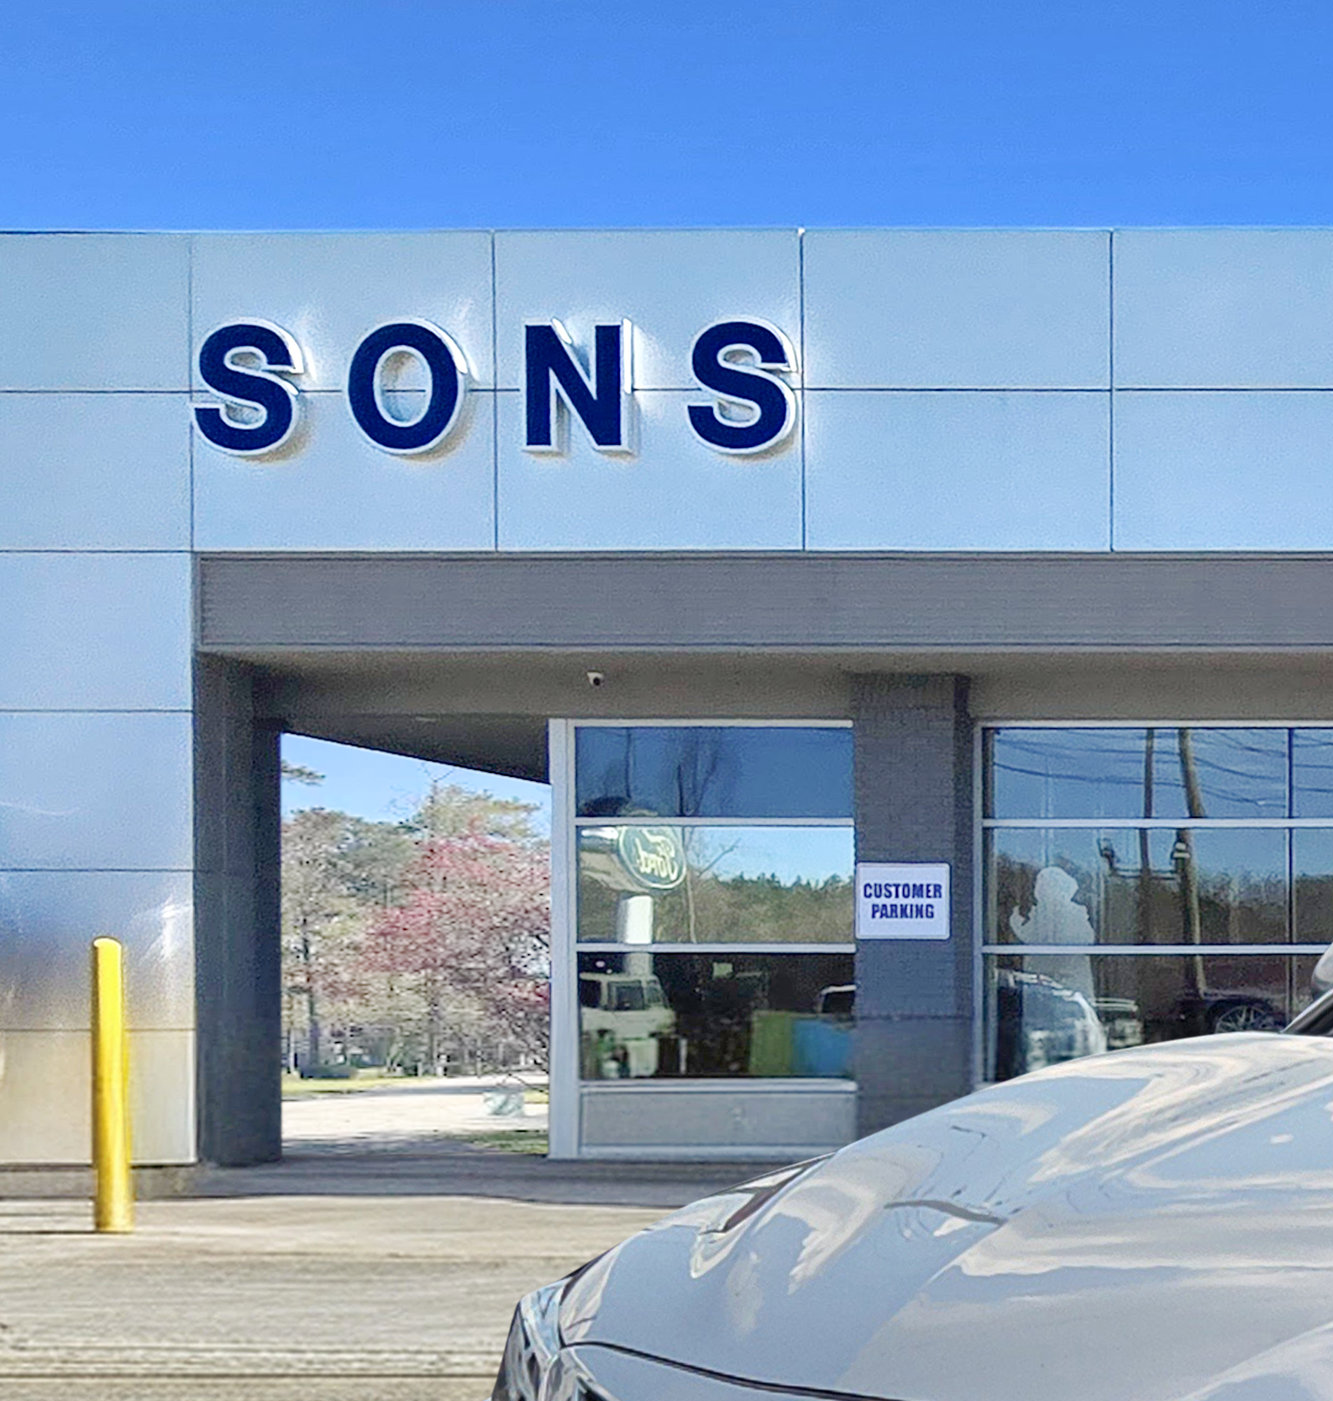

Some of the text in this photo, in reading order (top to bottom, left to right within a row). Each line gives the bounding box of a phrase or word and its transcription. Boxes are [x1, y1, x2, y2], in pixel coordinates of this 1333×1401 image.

[193, 321, 797, 452] SONS
[863, 882, 943, 899] CUSTOMER
[871, 903, 935, 919] PARKING
